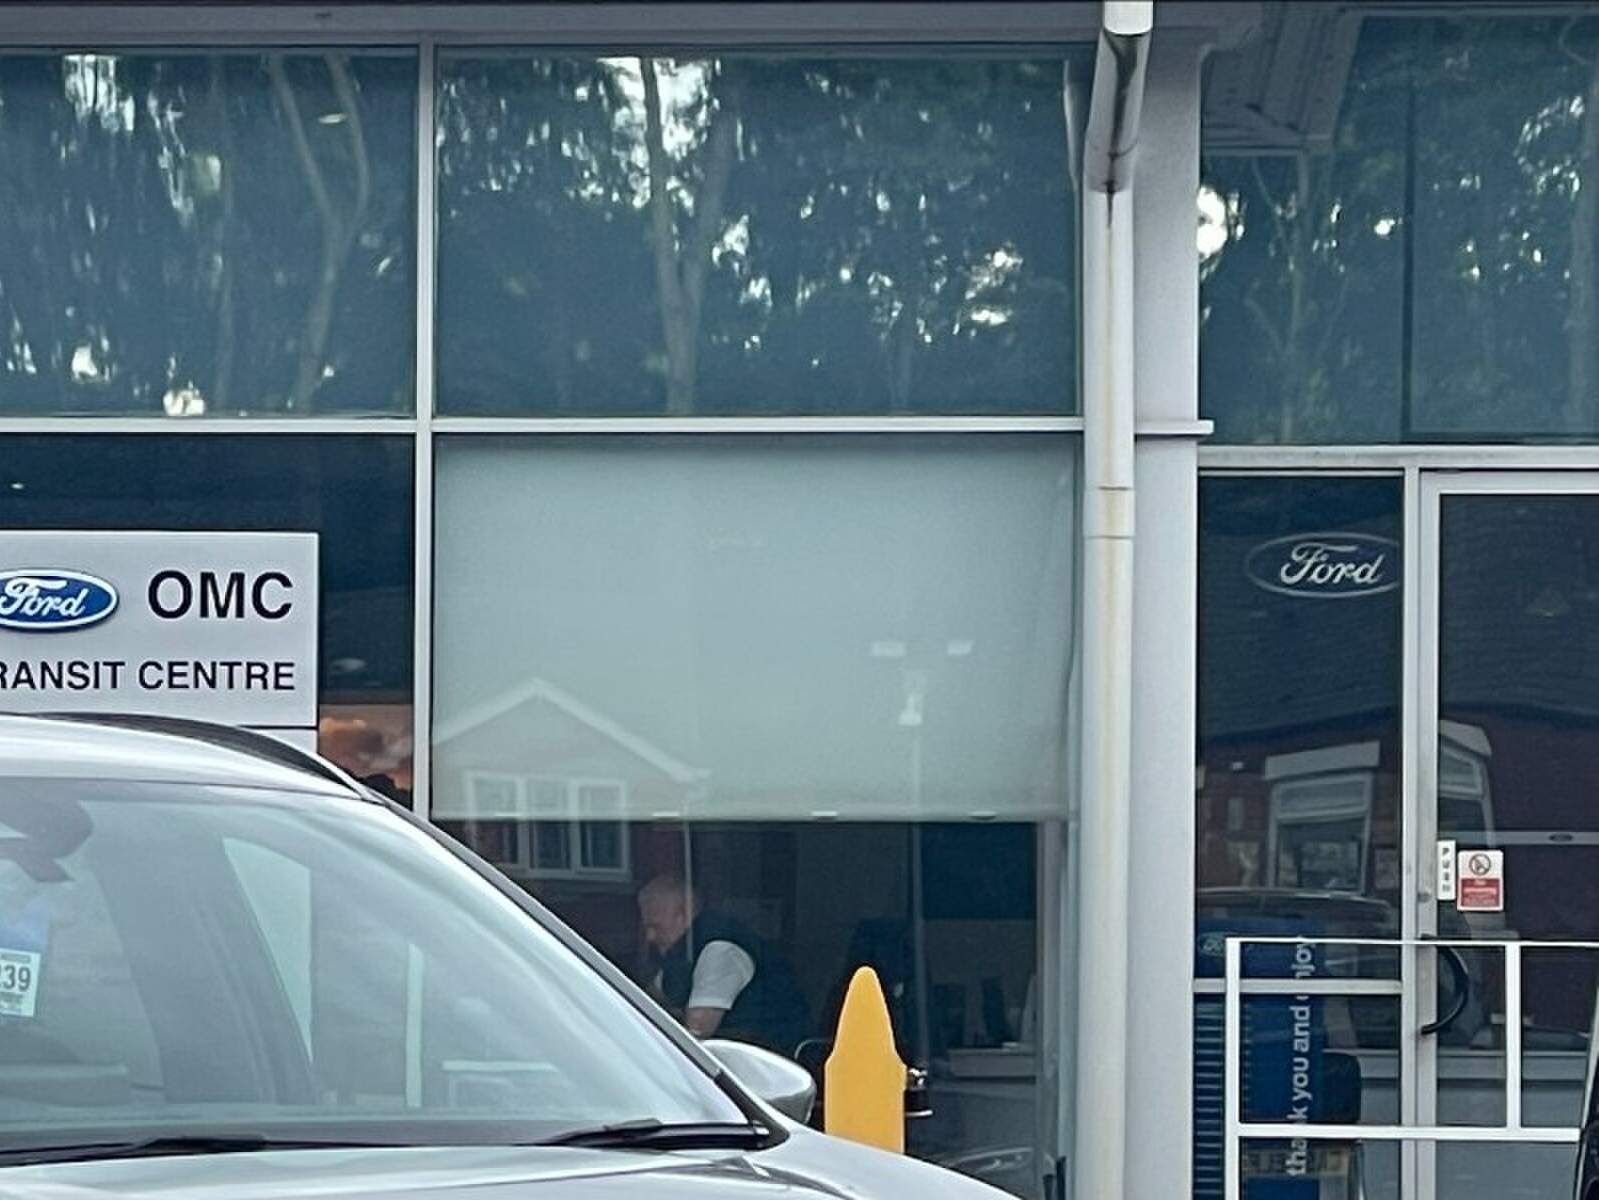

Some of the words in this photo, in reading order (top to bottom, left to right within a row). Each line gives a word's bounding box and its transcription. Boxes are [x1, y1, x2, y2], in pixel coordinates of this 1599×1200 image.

[1279, 541, 1387, 585] Ford
[147, 569, 294, 620] OMC
[138, 660, 297, 691] CENTRE
[1288, 1004, 1311, 1054] and
[1291, 1056, 1313, 1102] you
[1285, 1106, 1309, 1177] thak
